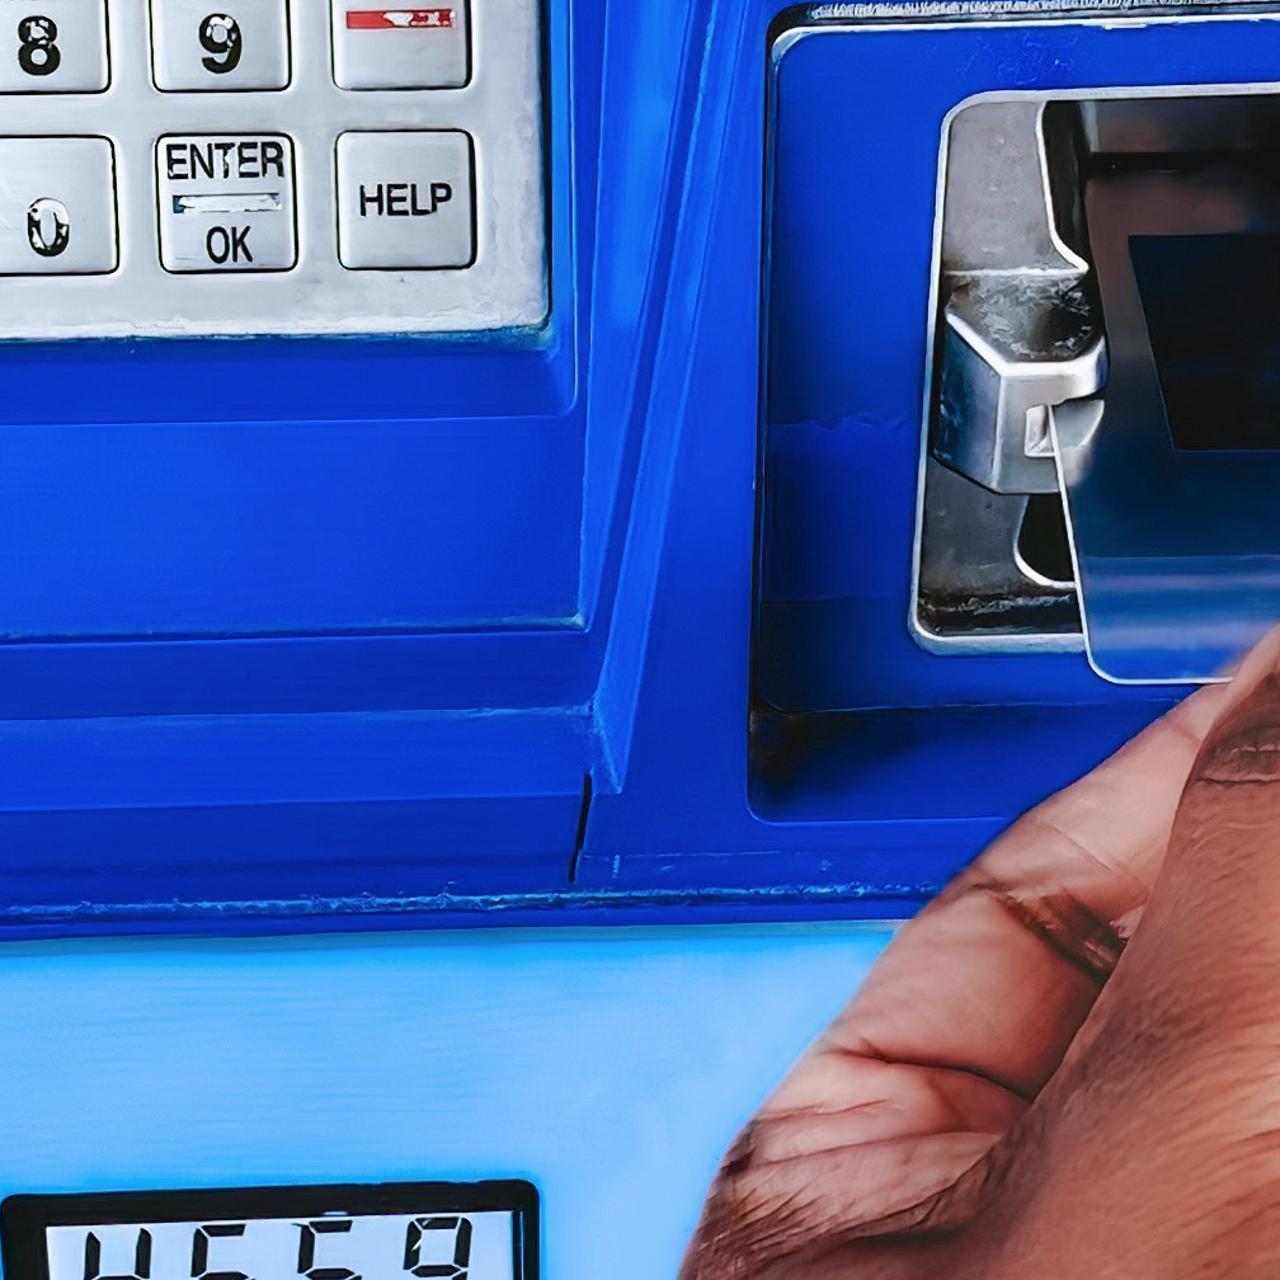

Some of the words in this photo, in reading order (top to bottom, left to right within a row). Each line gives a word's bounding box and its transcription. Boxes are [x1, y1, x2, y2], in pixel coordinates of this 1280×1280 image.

[17, 15, 61, 76] 8
[198, 13, 242, 74] 9
[165, 141, 285, 180] ENTER
[359, 182, 453, 217] HELP
[27, 197, 70, 258] 0
[206, 225, 254, 265] OK
